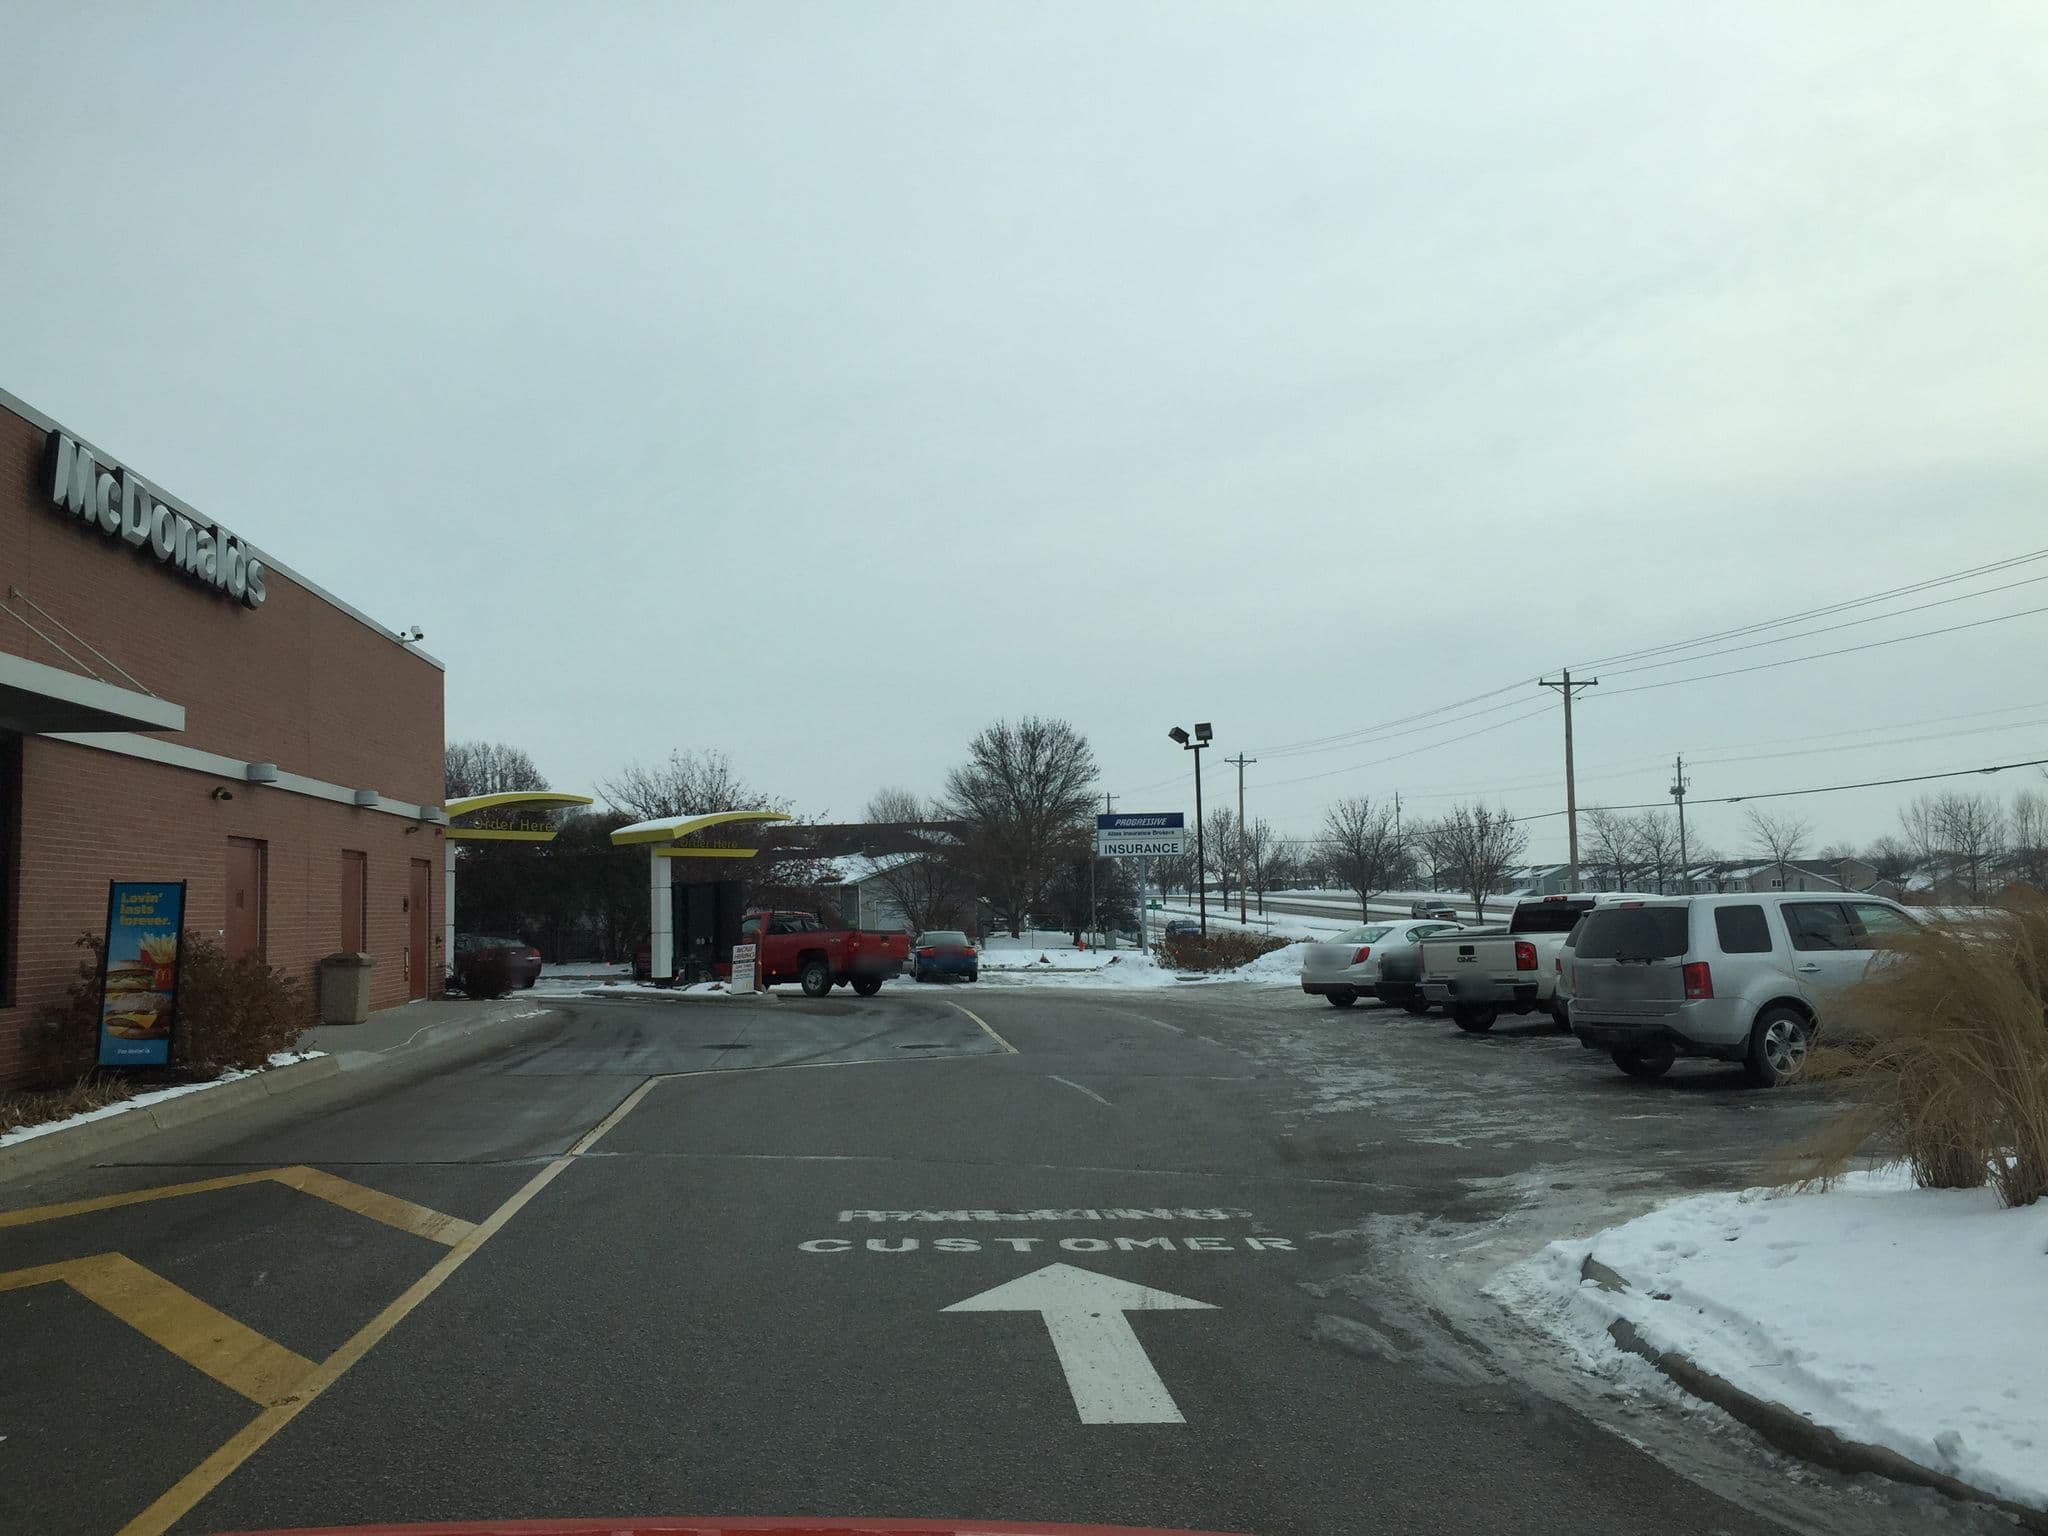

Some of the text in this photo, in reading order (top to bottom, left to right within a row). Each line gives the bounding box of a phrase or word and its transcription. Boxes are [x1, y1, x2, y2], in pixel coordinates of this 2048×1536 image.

[473, 817, 554, 832] Order Here
[1115, 817, 1168, 826] PROGRESSIVE
[680, 838, 738, 850] Order Here
[1104, 843, 1179, 854] INSURANCE
[798, 1235, 1298, 1253] CUSTOMER
